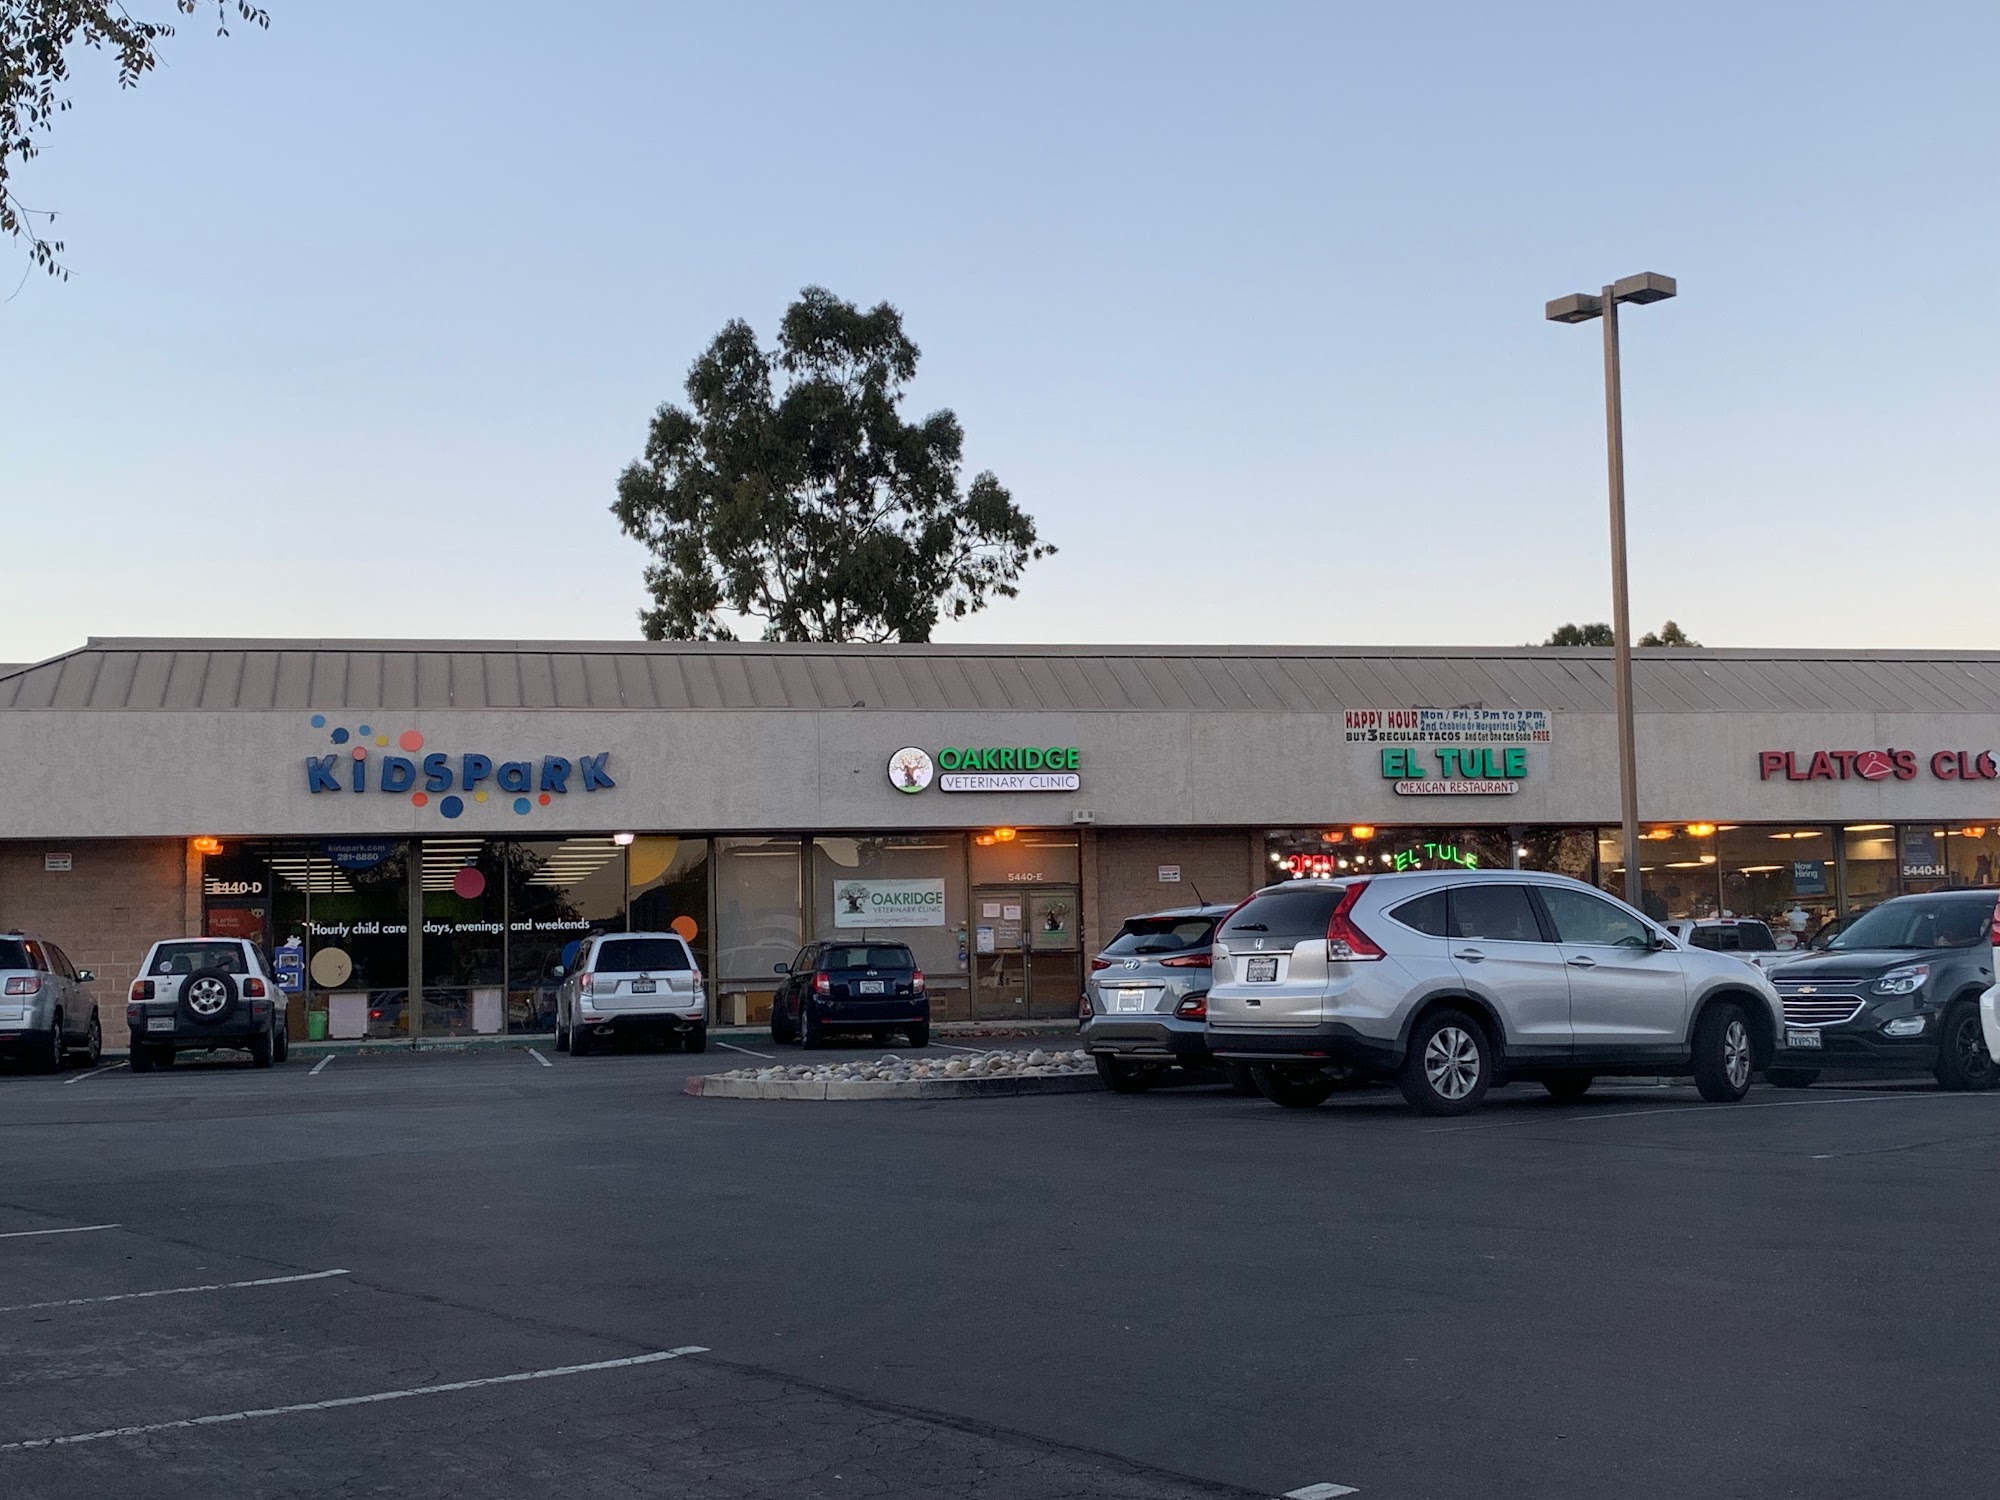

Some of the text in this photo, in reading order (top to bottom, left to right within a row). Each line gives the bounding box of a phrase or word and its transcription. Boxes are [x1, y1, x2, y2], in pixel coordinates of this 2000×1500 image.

[1345, 711, 1418, 729] HAPPY HOUR
[1420, 711, 1443, 719] Mon
[1474, 711, 1480, 719] 5
[1503, 711, 1515, 719] To
[1517, 711, 1523, 719] 7
[1476, 721, 1509, 732] Margarita
[1518, 720, 1533, 732] 50%
[1346, 732, 1366, 741] BUY
[1367, 729, 1378, 741] 3
[1380, 732, 1426, 741] REGULAR
[1428, 732, 1461, 741] TACOS
[1465, 732, 1477, 741] And
[1478, 732, 1489, 741] Get
[1490, 732, 1502, 741] One
[1503, 732, 1514, 741] Can
[1533, 731, 1550, 742] FREE
[938, 747, 1080, 770] OAKRIDGE
[1382, 748, 1528, 778] EL TULE
[946, 776, 1076, 789] VETERINARY CLINIC
[1400, 781, 1514, 793] MEXICAN RESTAURANT
[328, 844, 386, 852] kidspark.com
[1397, 843, 1478, 871] EL TULE
[1289, 855, 1334, 873] OPEN
[1794, 862, 1812, 870] Now
[1903, 865, 1945, 875] 5440-H
[1008, 873, 1043, 881] 5440-E
[1795, 870, 1818, 879] Hiring
[212, 882, 262, 894] 5440-D
[871, 892, 943, 905] OAKRIDGE
[311, 918, 590, 937] Hourly child care days, evenings and weekends
